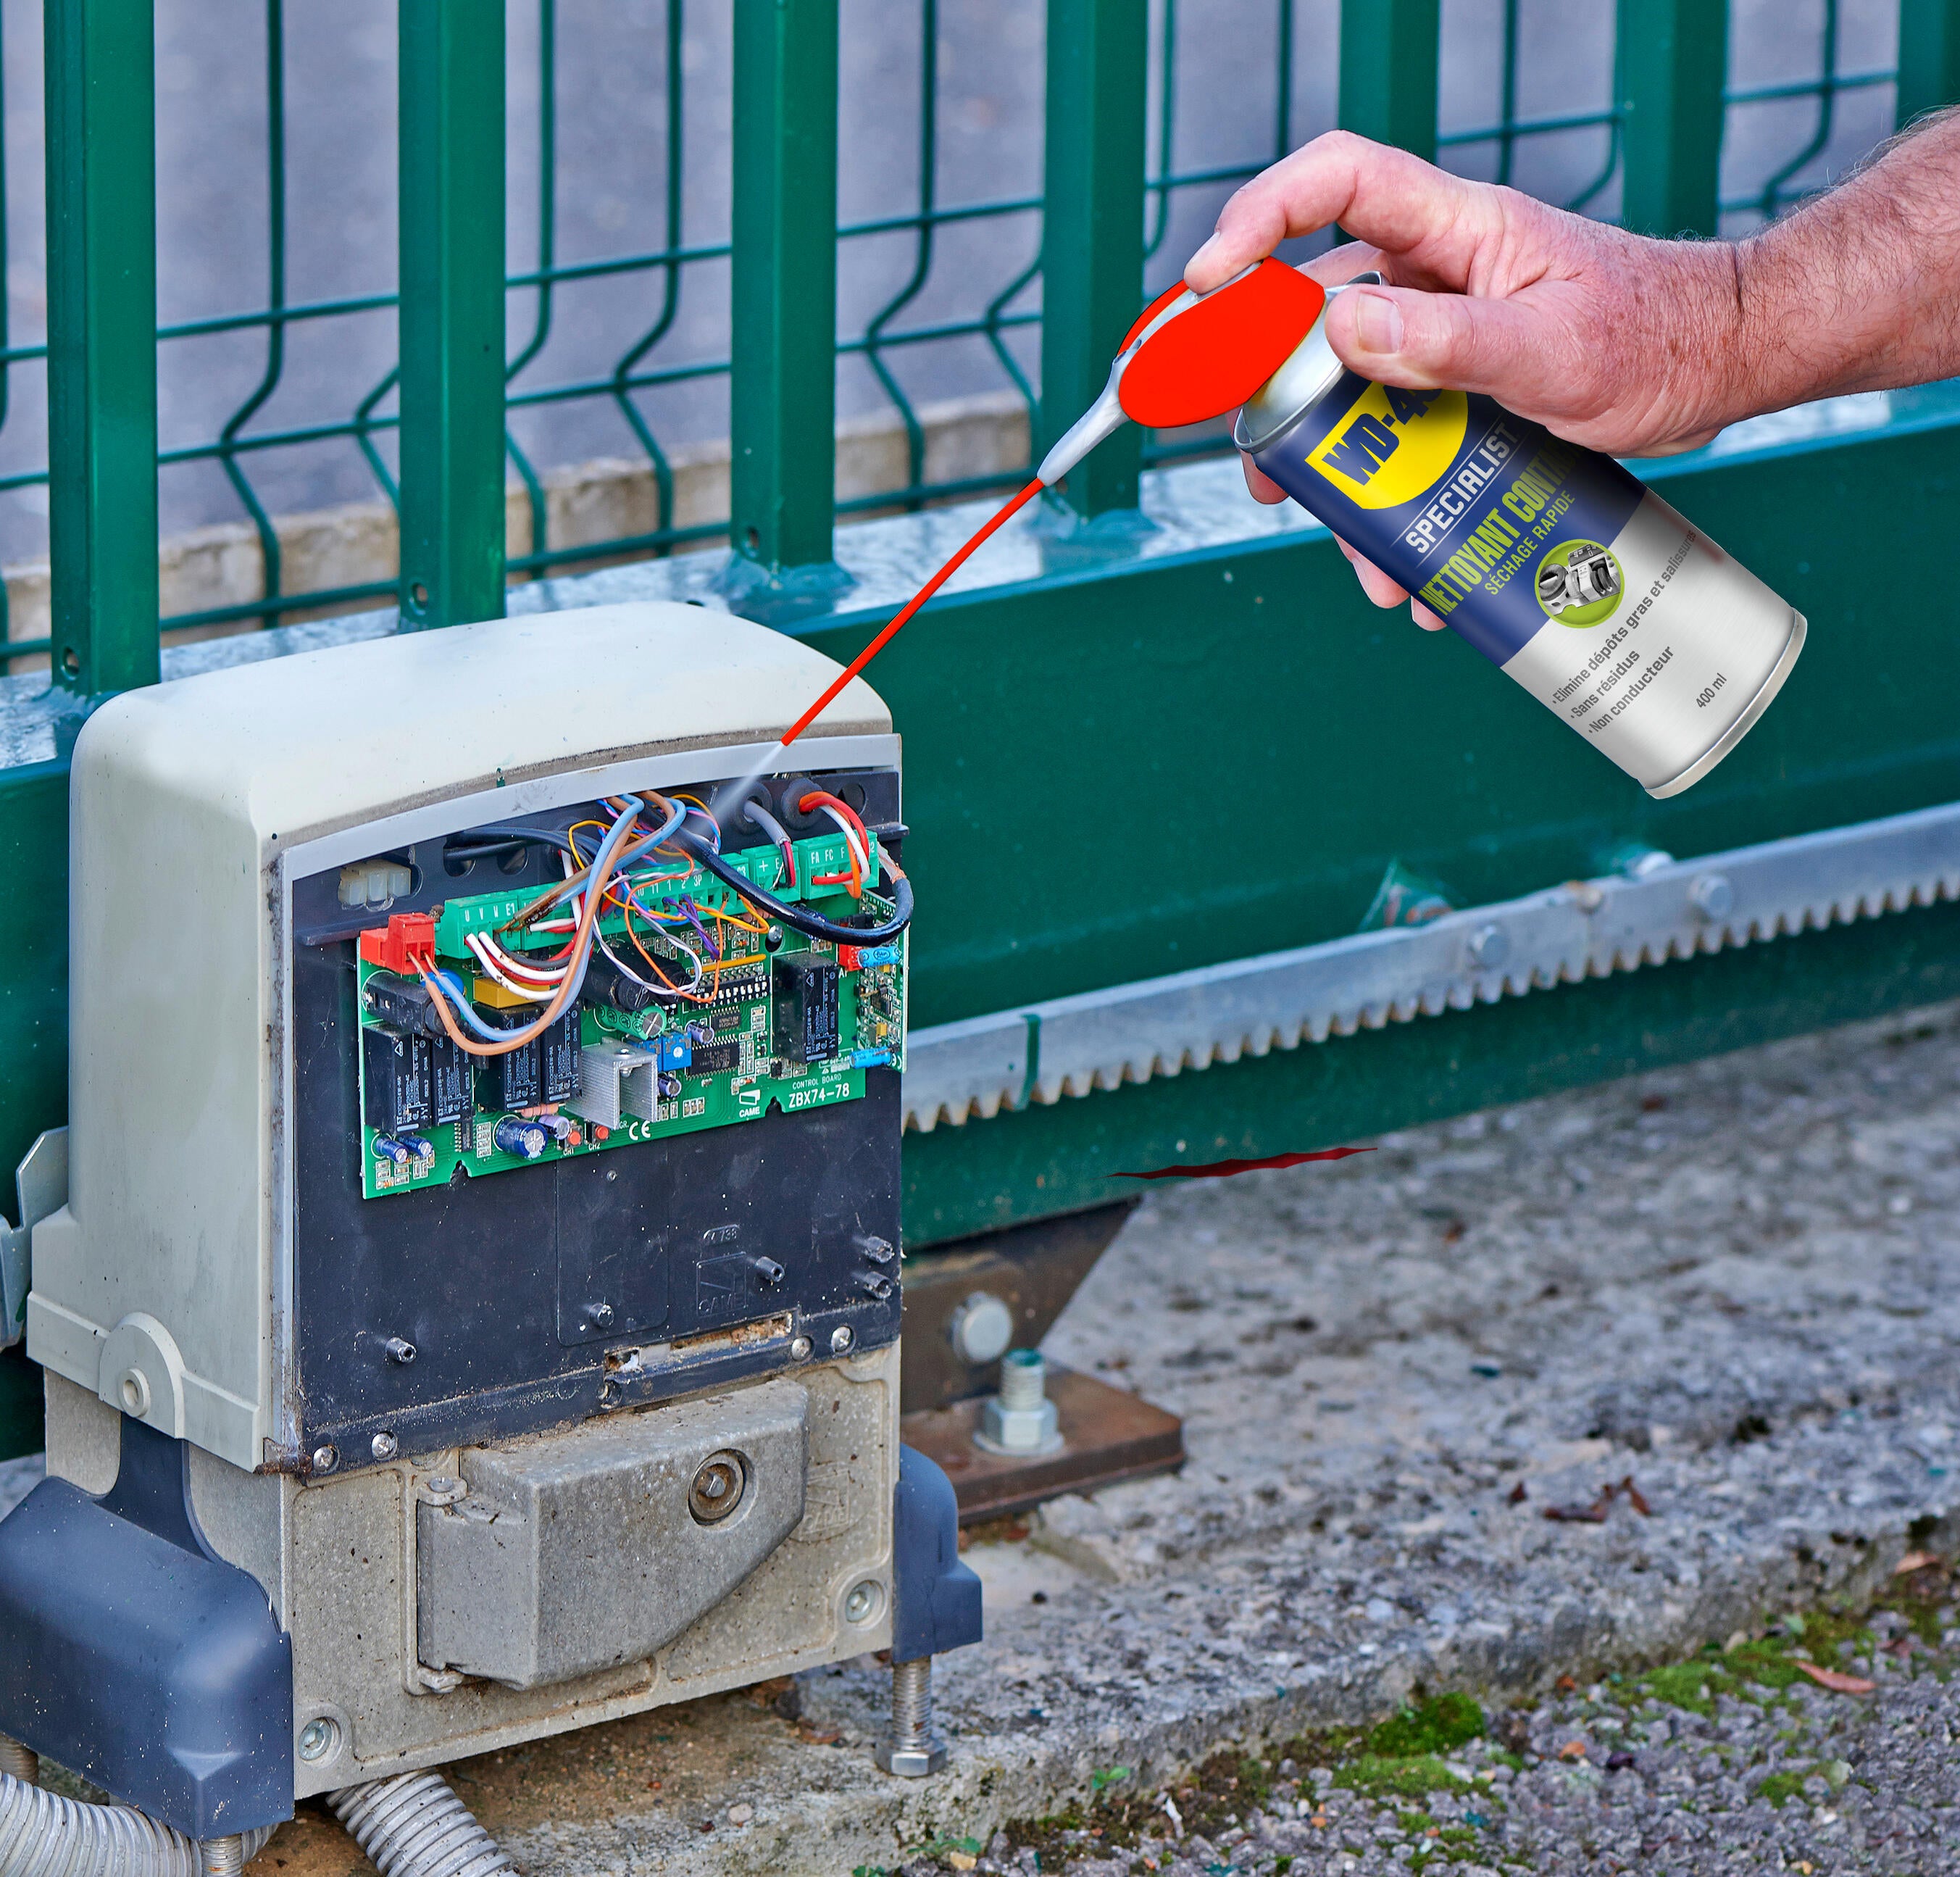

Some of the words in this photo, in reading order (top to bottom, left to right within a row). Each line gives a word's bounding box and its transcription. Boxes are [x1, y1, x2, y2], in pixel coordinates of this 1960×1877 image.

[1406, 422, 1519, 554] SPECIALIST
[1418, 507, 1521, 617] NETTOYANT
[1484, 536, 1538, 595] SÉCHAGE
[1531, 490, 1576, 541] RAPIDE
[1588, 625, 1628, 670] dépôts
[1626, 596, 1654, 629] gras
[1650, 580, 1665, 597] et
[1661, 530, 1697, 583] salissures
[1571, 693, 1599, 719] Sans
[1596, 650, 1640, 697] résidus
[1588, 712, 1614, 734] Non
[1610, 646, 1675, 717] conducteur
[1696, 687, 1716, 709] 400
[1711, 673, 1727, 691] ml
[811, 852, 820, 865] FA
[825, 849, 833, 862] FC
[464, 910, 470, 922] U
[479, 908, 484, 920] V
[506, 903, 515, 916] E1
[788, 1083, 850, 1109] ZBX74-78
[792, 1079, 819, 1090] CONTROL
[822, 1075, 841, 1085] BOARD
[739, 1107, 760, 1118] CAME
